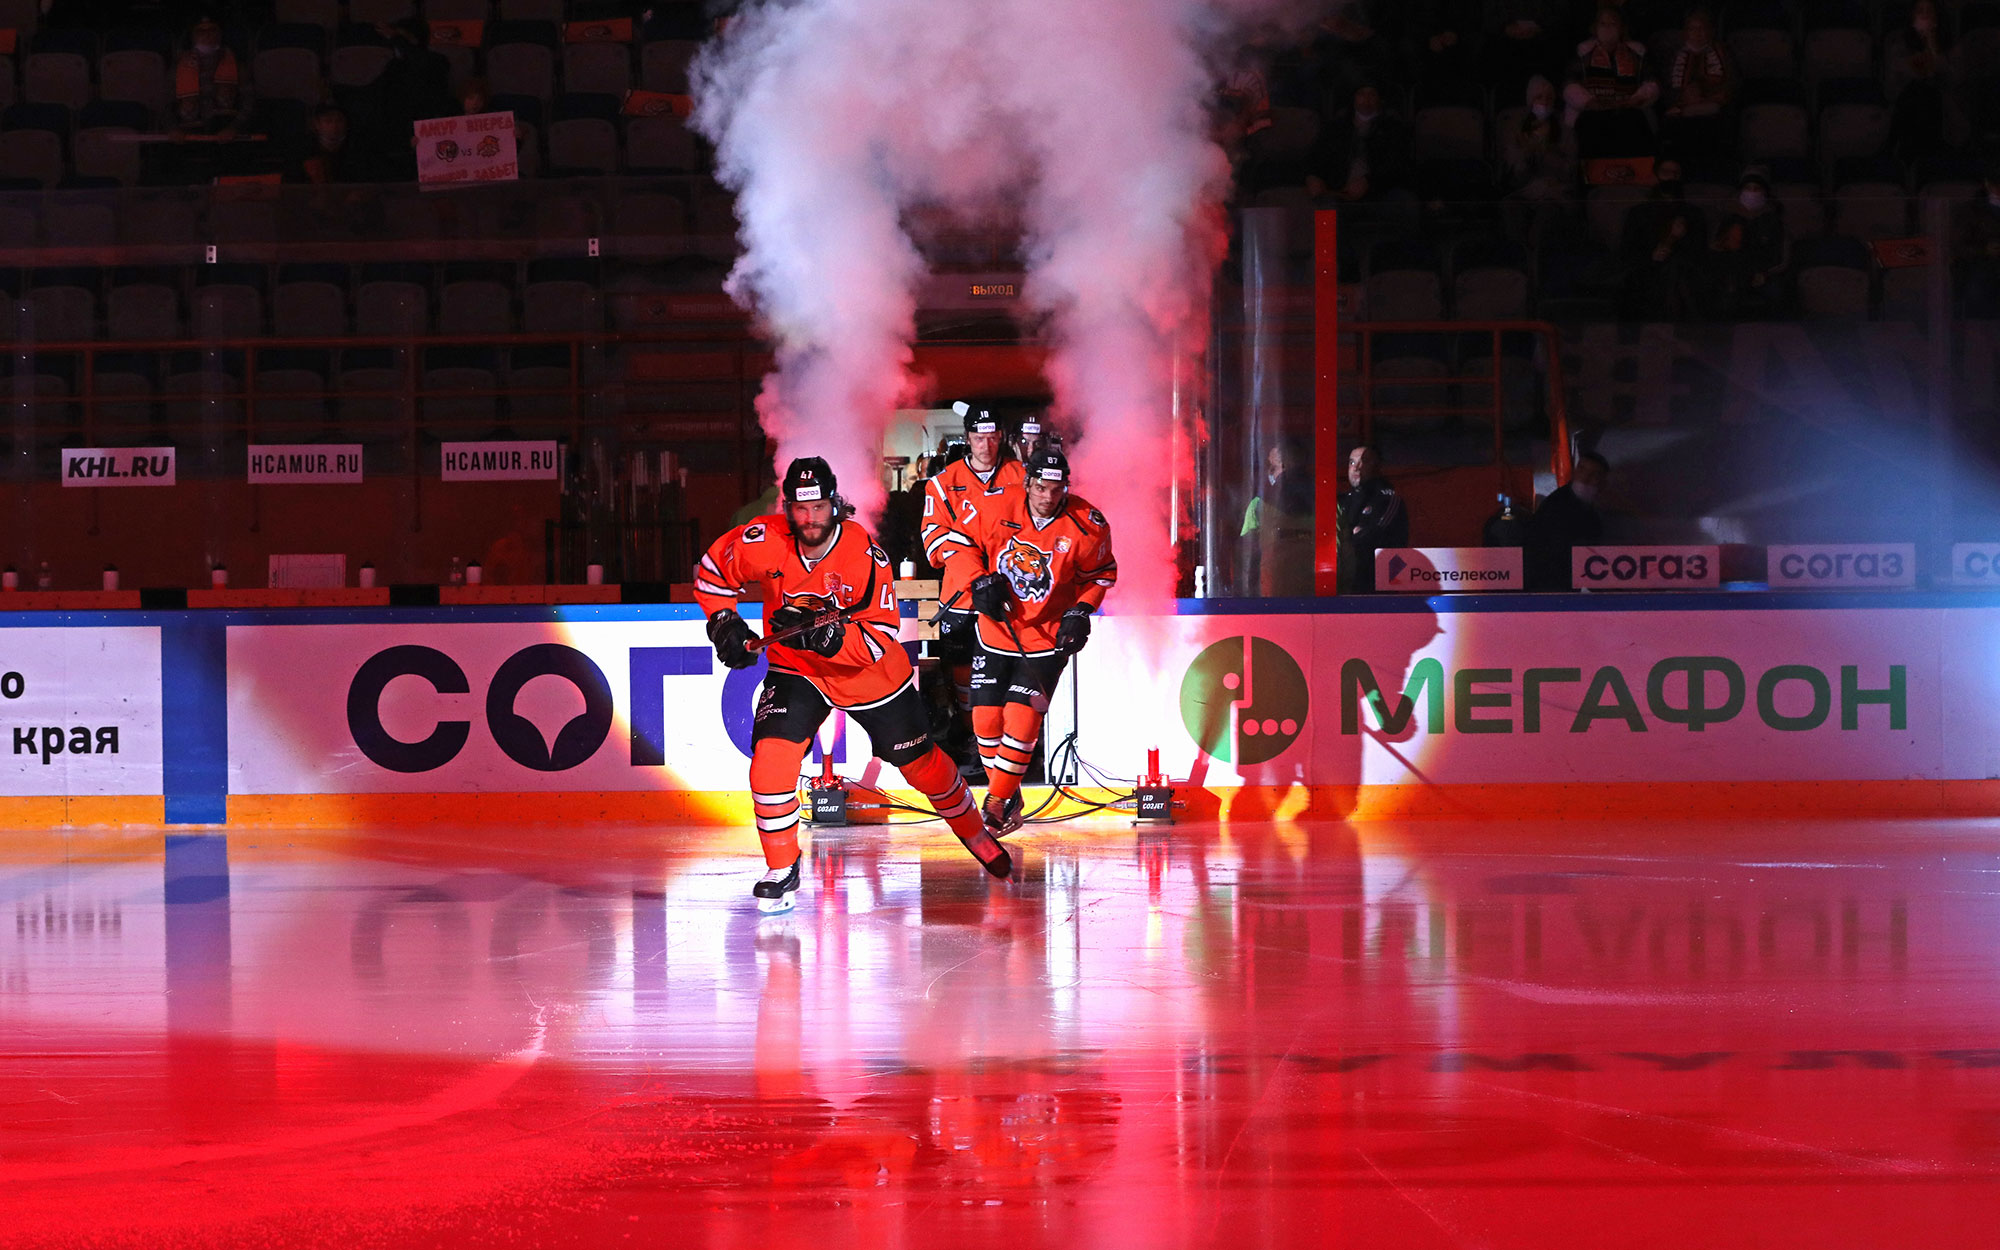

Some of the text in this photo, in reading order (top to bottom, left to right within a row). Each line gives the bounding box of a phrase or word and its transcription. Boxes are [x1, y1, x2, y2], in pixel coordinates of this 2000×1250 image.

[419, 120, 457, 136] АМУР
[972, 285, 1014, 295] ВЫХОД
[67, 456, 170, 478] KHL.RU
[252, 454, 359, 475] HCAMUR.RU
[446, 450, 553, 473] HCAMUR.RU
[800, 470, 813, 479] 47
[1410, 567, 1511, 582] Ростелеком
[814, 610, 841, 628] BAUER
[1008, 684, 1043, 697] BAUE
[13, 727, 119, 765] края
[893, 733, 928, 750] BAUER
[1142, 794, 1154, 802] LED
